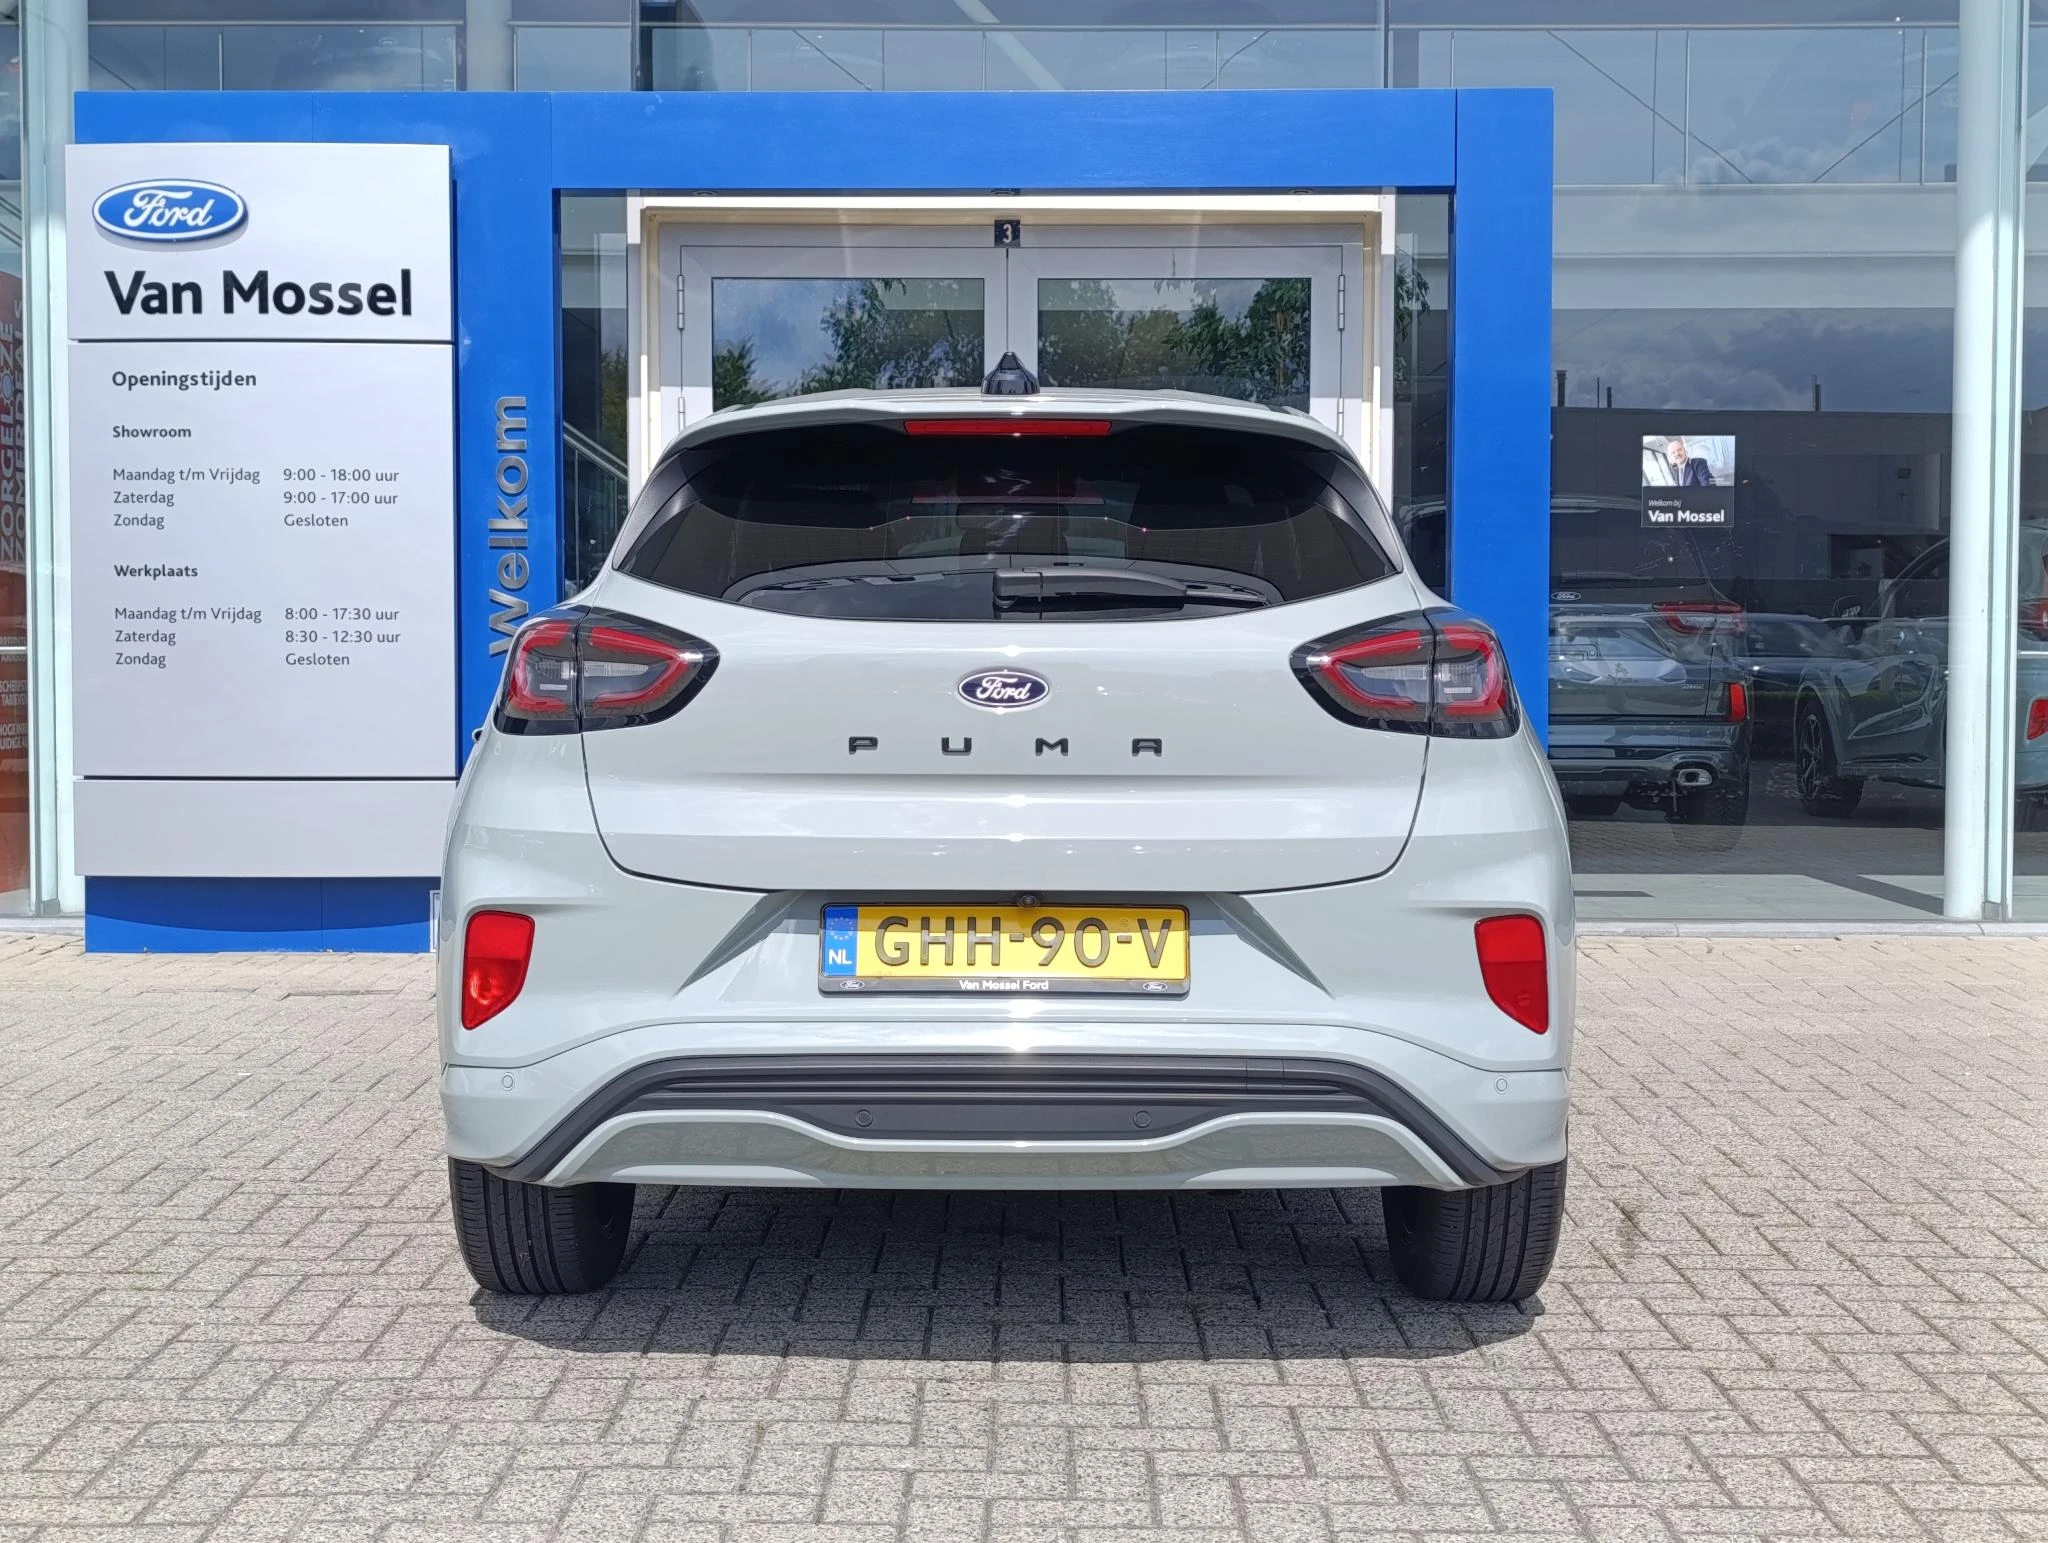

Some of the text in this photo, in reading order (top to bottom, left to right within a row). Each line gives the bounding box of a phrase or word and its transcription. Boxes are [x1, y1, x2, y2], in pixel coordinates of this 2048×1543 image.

[123, 188, 217, 229] Ford
[1002, 223, 1012, 244] 3
[104, 269, 412, 317] Van Mossel
[112, 370, 257, 391] Openingstijden
[113, 424, 192, 438] Showroom
[113, 467, 176, 484] Maandag
[179, 467, 205, 481] t/m
[209, 467, 261, 484] Vrijdag
[283, 469, 316, 481] 9:00
[331, 469, 371, 481] 18:00
[375, 473, 400, 481] uur
[113, 490, 175, 507] Zaterdag
[283, 492, 316, 504] 9:00
[331, 492, 370, 504] 17:00
[374, 496, 399, 504] uur
[114, 513, 349, 530] Zondag Gesloten
[1648, 509, 1725, 523] Van Mossel
[488, 396, 529, 656] Welkom
[114, 564, 199, 581] Werkplaats
[115, 606, 177, 624] Maandag
[180, 606, 206, 621] t/m
[211, 606, 263, 624] Vrijdag
[285, 608, 318, 620] 8:00
[333, 608, 372, 620] 17:30
[376, 612, 400, 620] uur
[115, 629, 177, 646] Zaterdag
[285, 631, 318, 643] 8:30
[332, 631, 373, 643] 12:30
[377, 635, 401, 643] uur
[115, 652, 350, 669] Zondag Gesloten
[976, 676, 1030, 701] Ford
[849, 737, 1162, 757] PUMA
[875, 915, 1172, 968] GHH-90-V
[828, 948, 852, 965] NL
[959, 980, 1049, 990] Van Mossel Ford
